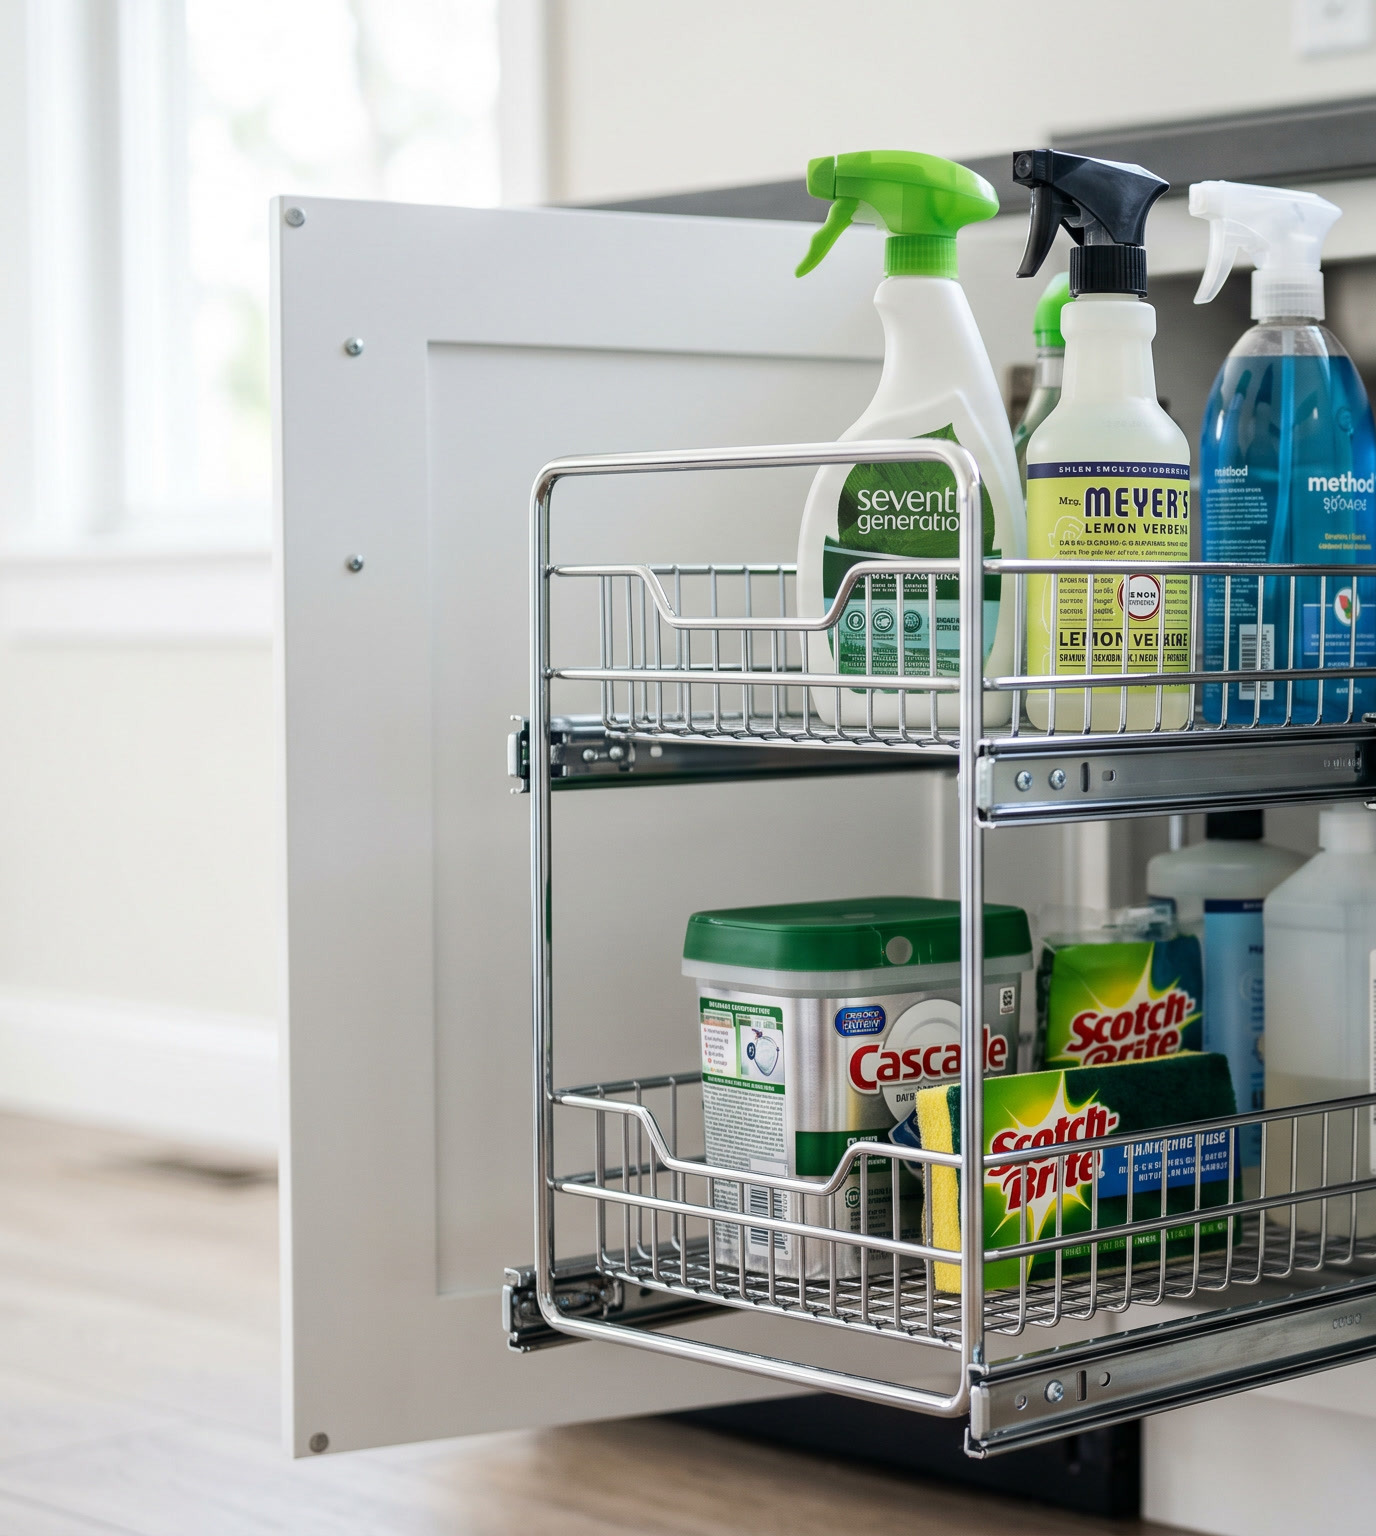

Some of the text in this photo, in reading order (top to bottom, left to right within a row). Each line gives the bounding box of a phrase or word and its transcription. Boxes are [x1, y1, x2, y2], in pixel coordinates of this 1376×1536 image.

[1308, 471, 1374, 493] method
[1085, 487, 1188, 519] MEYER'S
[857, 513, 960, 534] generatio
[1085, 523, 1137, 534] LEMON
[850, 1025, 1007, 1091] Cascae
